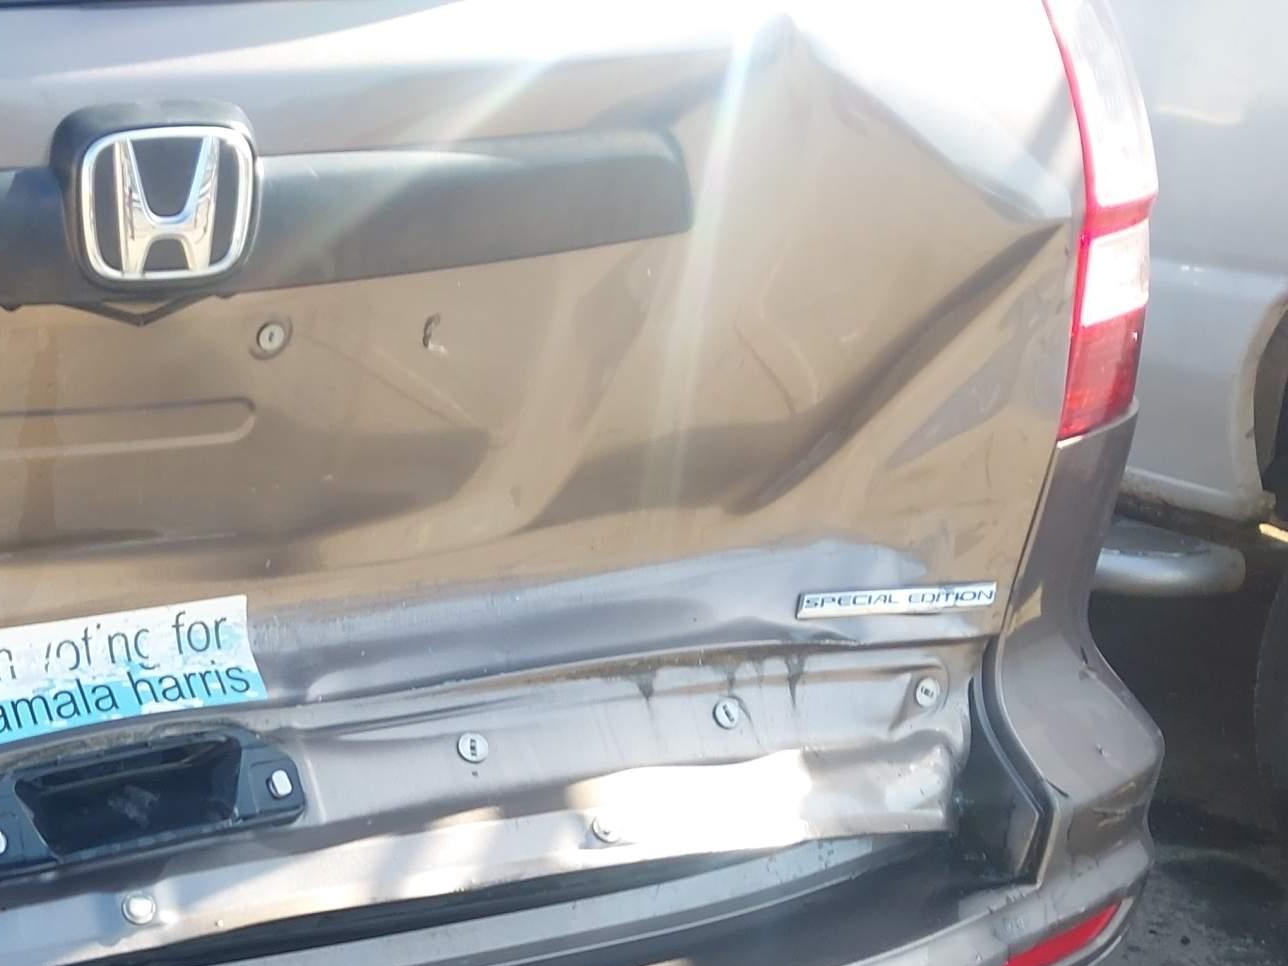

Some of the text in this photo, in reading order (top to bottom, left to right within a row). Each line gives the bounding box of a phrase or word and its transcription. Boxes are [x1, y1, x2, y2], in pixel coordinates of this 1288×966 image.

[804, 589, 994, 609] SPECIAL EDITION
[44, 622, 161, 672] otng
[171, 610, 228, 655] for
[126, 659, 251, 706] harris
